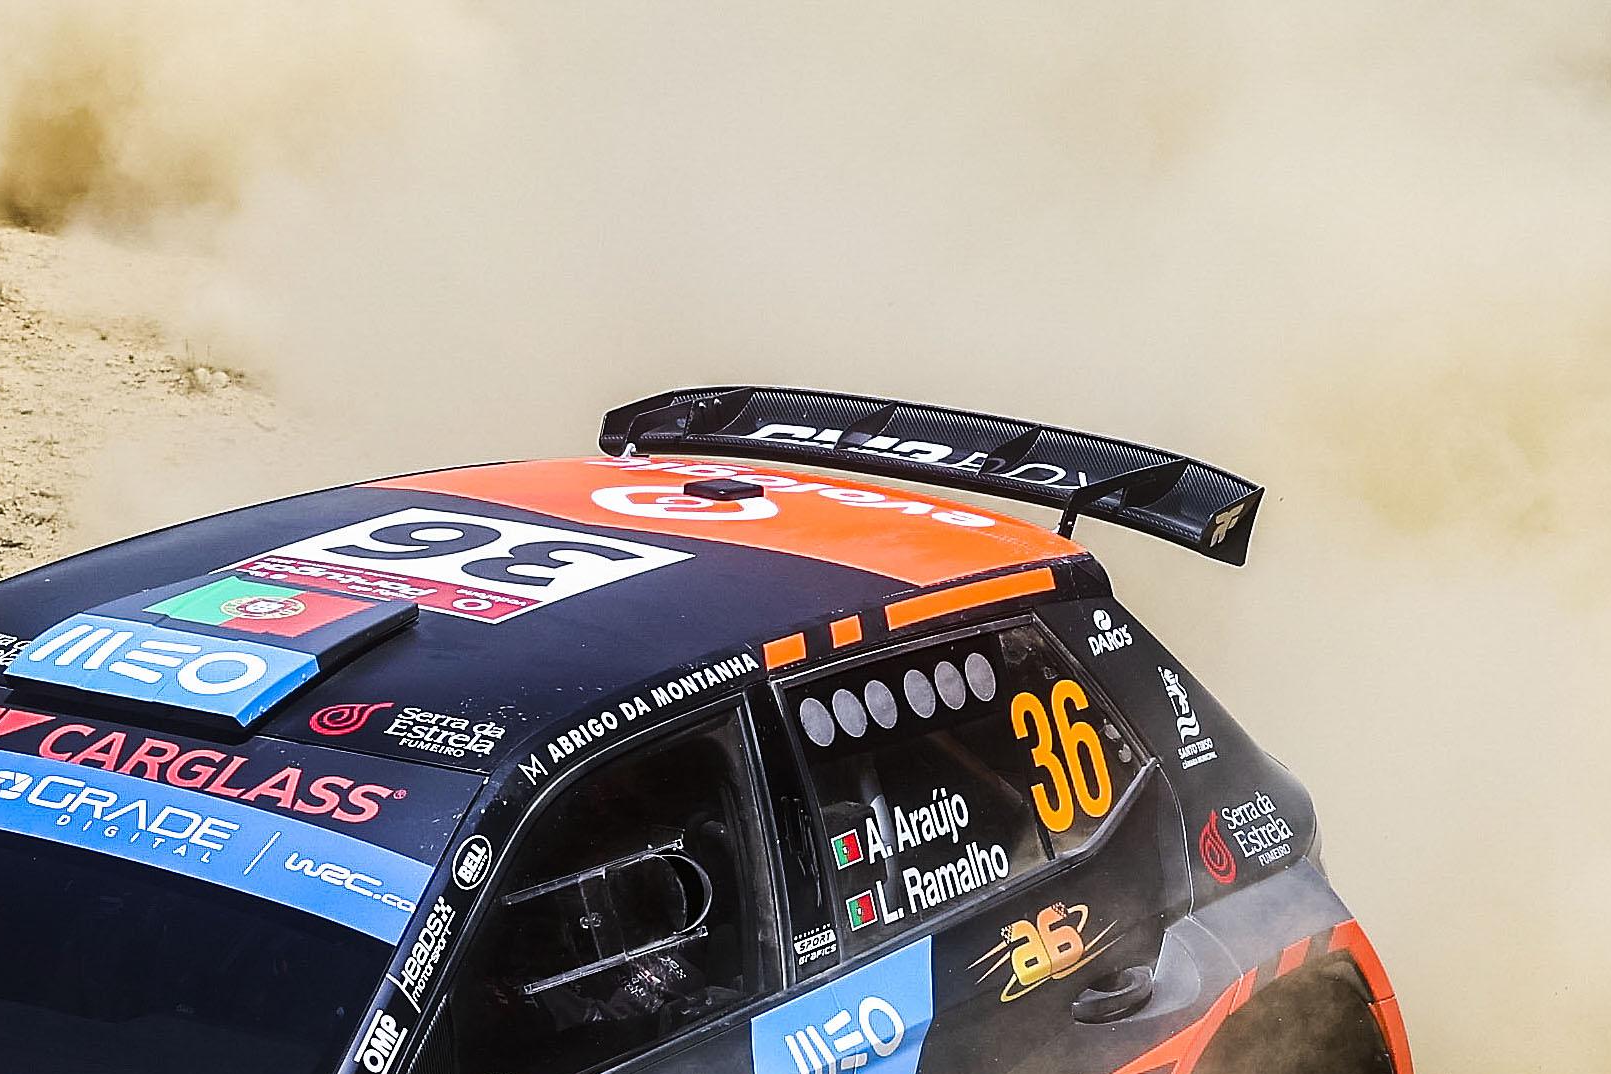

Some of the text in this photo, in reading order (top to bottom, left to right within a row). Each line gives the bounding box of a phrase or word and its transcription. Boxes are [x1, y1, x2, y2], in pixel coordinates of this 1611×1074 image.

[323, 521, 644, 587] 36
[28, 624, 268, 695] MEO
[397, 706, 506, 739] Serra da
[546, 711, 620, 764] ABRIGO
[620, 696, 651, 722] DA
[654, 652, 760, 706] MONTANHA
[384, 719, 495, 755] Estrela
[399, 737, 465, 758] FUMEIRO
[1011, 679, 1113, 832] 36
[865, 788, 969, 864] A. Araújo
[1221, 791, 1276, 830] Serra da
[1233, 814, 1294, 858] Estrela
[57, 814, 212, 863] DIGITAL
[457, 843, 486, 884] BELL
[876, 842, 1010, 924] L. Ramalho
[363, 1014, 400, 1074] OMP
